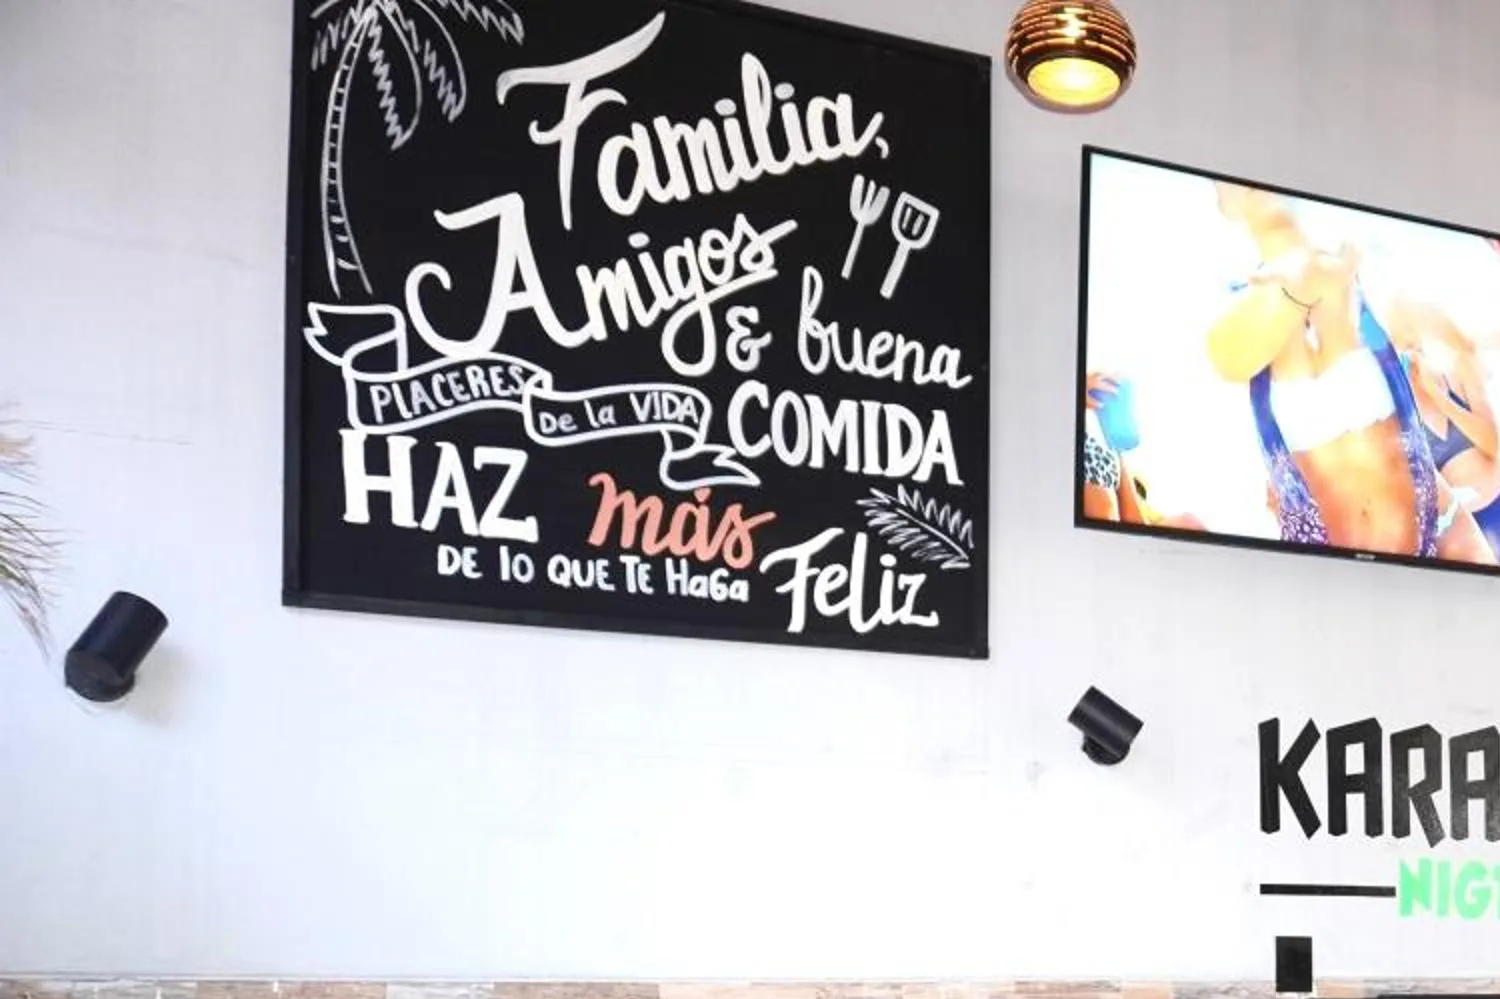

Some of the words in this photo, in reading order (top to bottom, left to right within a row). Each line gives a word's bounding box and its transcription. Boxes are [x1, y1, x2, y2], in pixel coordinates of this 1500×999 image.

[496, 12, 889, 230] Familia,
[404, 192, 798, 375] Amigos
[725, 305, 773, 371] &
[798, 266, 971, 390] buena
[370, 363, 528, 424] PLACERES
[583, 398, 617, 426] la
[629, 391, 700, 424] VIDA
[727, 381, 964, 487] COMIDA
[339, 429, 539, 542] HAZ
[587, 472, 777, 570] más
[437, 544, 483, 579] DE
[547, 554, 615, 592] QUE
[619, 555, 654, 595] TE
[759, 527, 939, 634] Feliz
